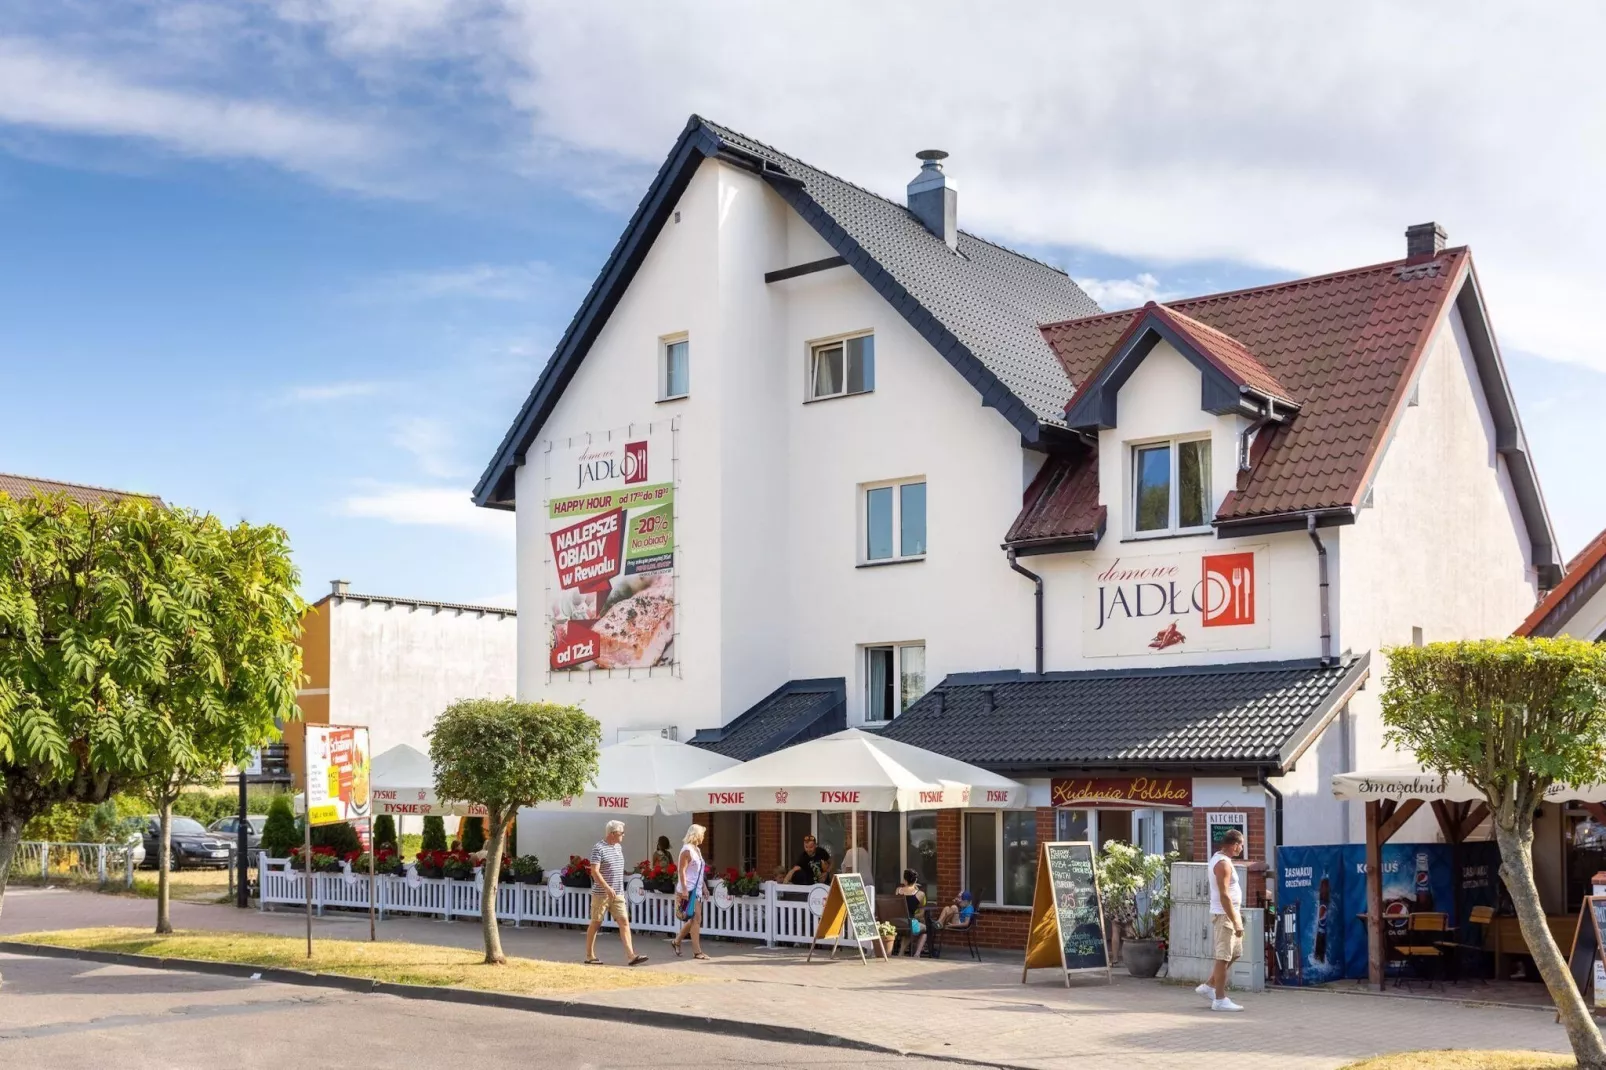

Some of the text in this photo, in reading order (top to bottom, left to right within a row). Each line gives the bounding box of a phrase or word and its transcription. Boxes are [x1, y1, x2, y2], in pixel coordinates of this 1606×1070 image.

[554, 500, 586, 514] HAPPY
[586, 496, 612, 510] HOUR
[618, 493, 628, 504] od
[643, 490, 653, 501] do
[556, 514, 618, 552] NAJLEPSZE
[558, 537, 607, 570] OBIADY
[562, 574, 573, 586] w
[574, 556, 615, 582] Rewalu
[1098, 557, 1180, 582] domowe
[1094, 577, 1225, 630] JADŁO
[557, 645, 571, 664] od
[373, 790, 397, 800] TYSKIE
[986, 790, 1008, 802] TYSKIE
[1053, 777, 1189, 801] Kuchnia Polska
[597, 796, 629, 808] TYSKIE
[708, 792, 745, 804] TYSKIE
[819, 791, 860, 803] TYSKIE
[919, 791, 944, 803] TYSKIE
[384, 803, 418, 813] TYSKIE
[1210, 814, 1244, 823] KITCHEN
